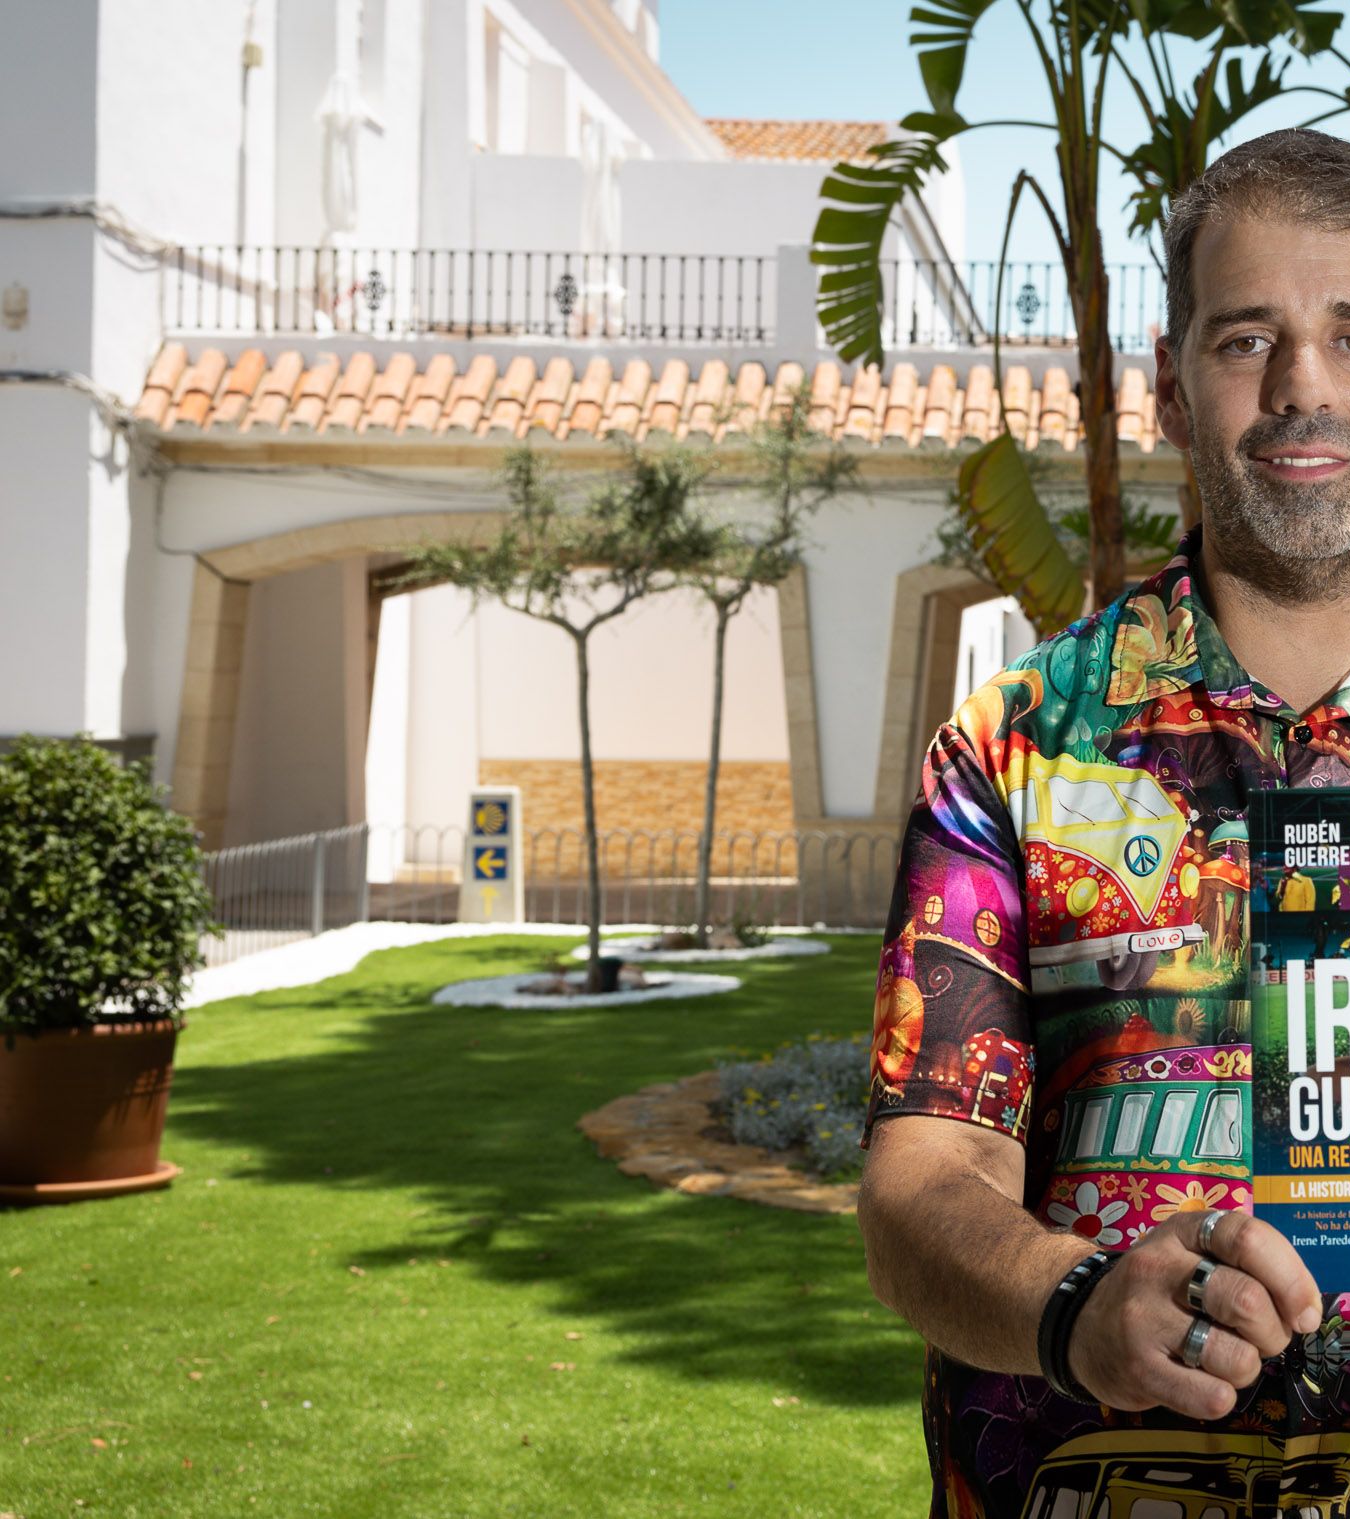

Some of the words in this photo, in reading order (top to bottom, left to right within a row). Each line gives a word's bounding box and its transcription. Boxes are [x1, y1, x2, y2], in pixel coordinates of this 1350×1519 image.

[1284, 819, 1340, 844] RUBÉN
[1290, 1146, 1324, 1168] UNA
[1290, 1182, 1306, 1198] LA
[1307, 1210, 1336, 1219] historia
[1337, 1210, 1347, 1219] de
[1315, 1221, 1328, 1230] No
[1330, 1220, 1341, 1230] ha
[1292, 1235, 1318, 1246] Irene
